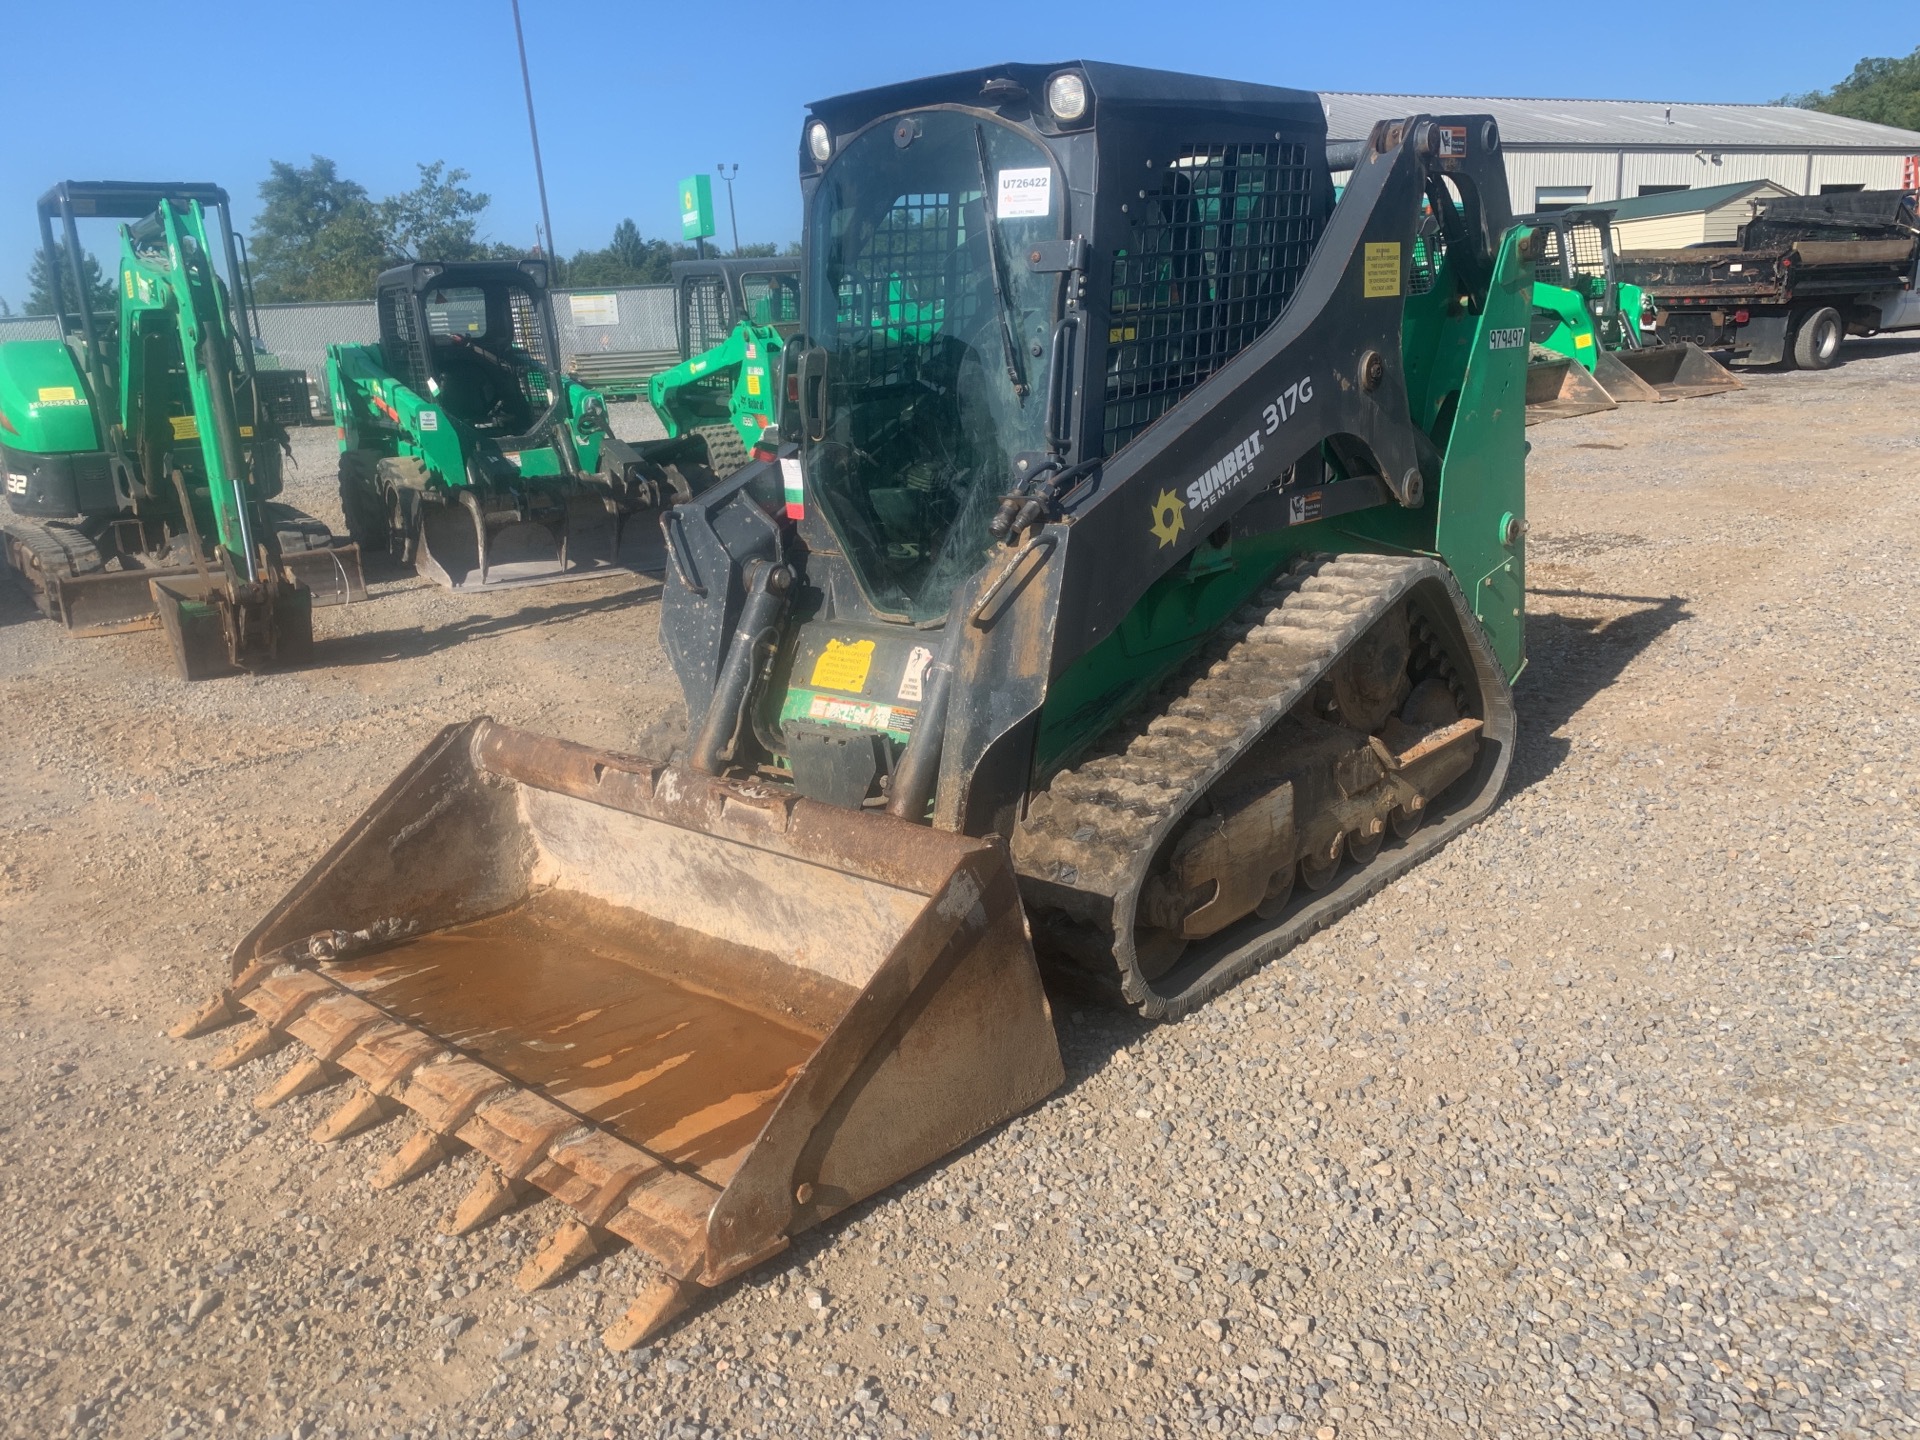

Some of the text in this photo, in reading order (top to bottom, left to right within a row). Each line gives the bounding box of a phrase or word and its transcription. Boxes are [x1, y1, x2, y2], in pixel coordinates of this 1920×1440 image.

[1003, 178, 1048, 189] U726422
[1490, 330, 1523, 348] 979497
[1262, 376, 1314, 436] 317G
[1186, 430, 1261, 510] SUNBELT
[1202, 462, 1254, 512] RENTALS
